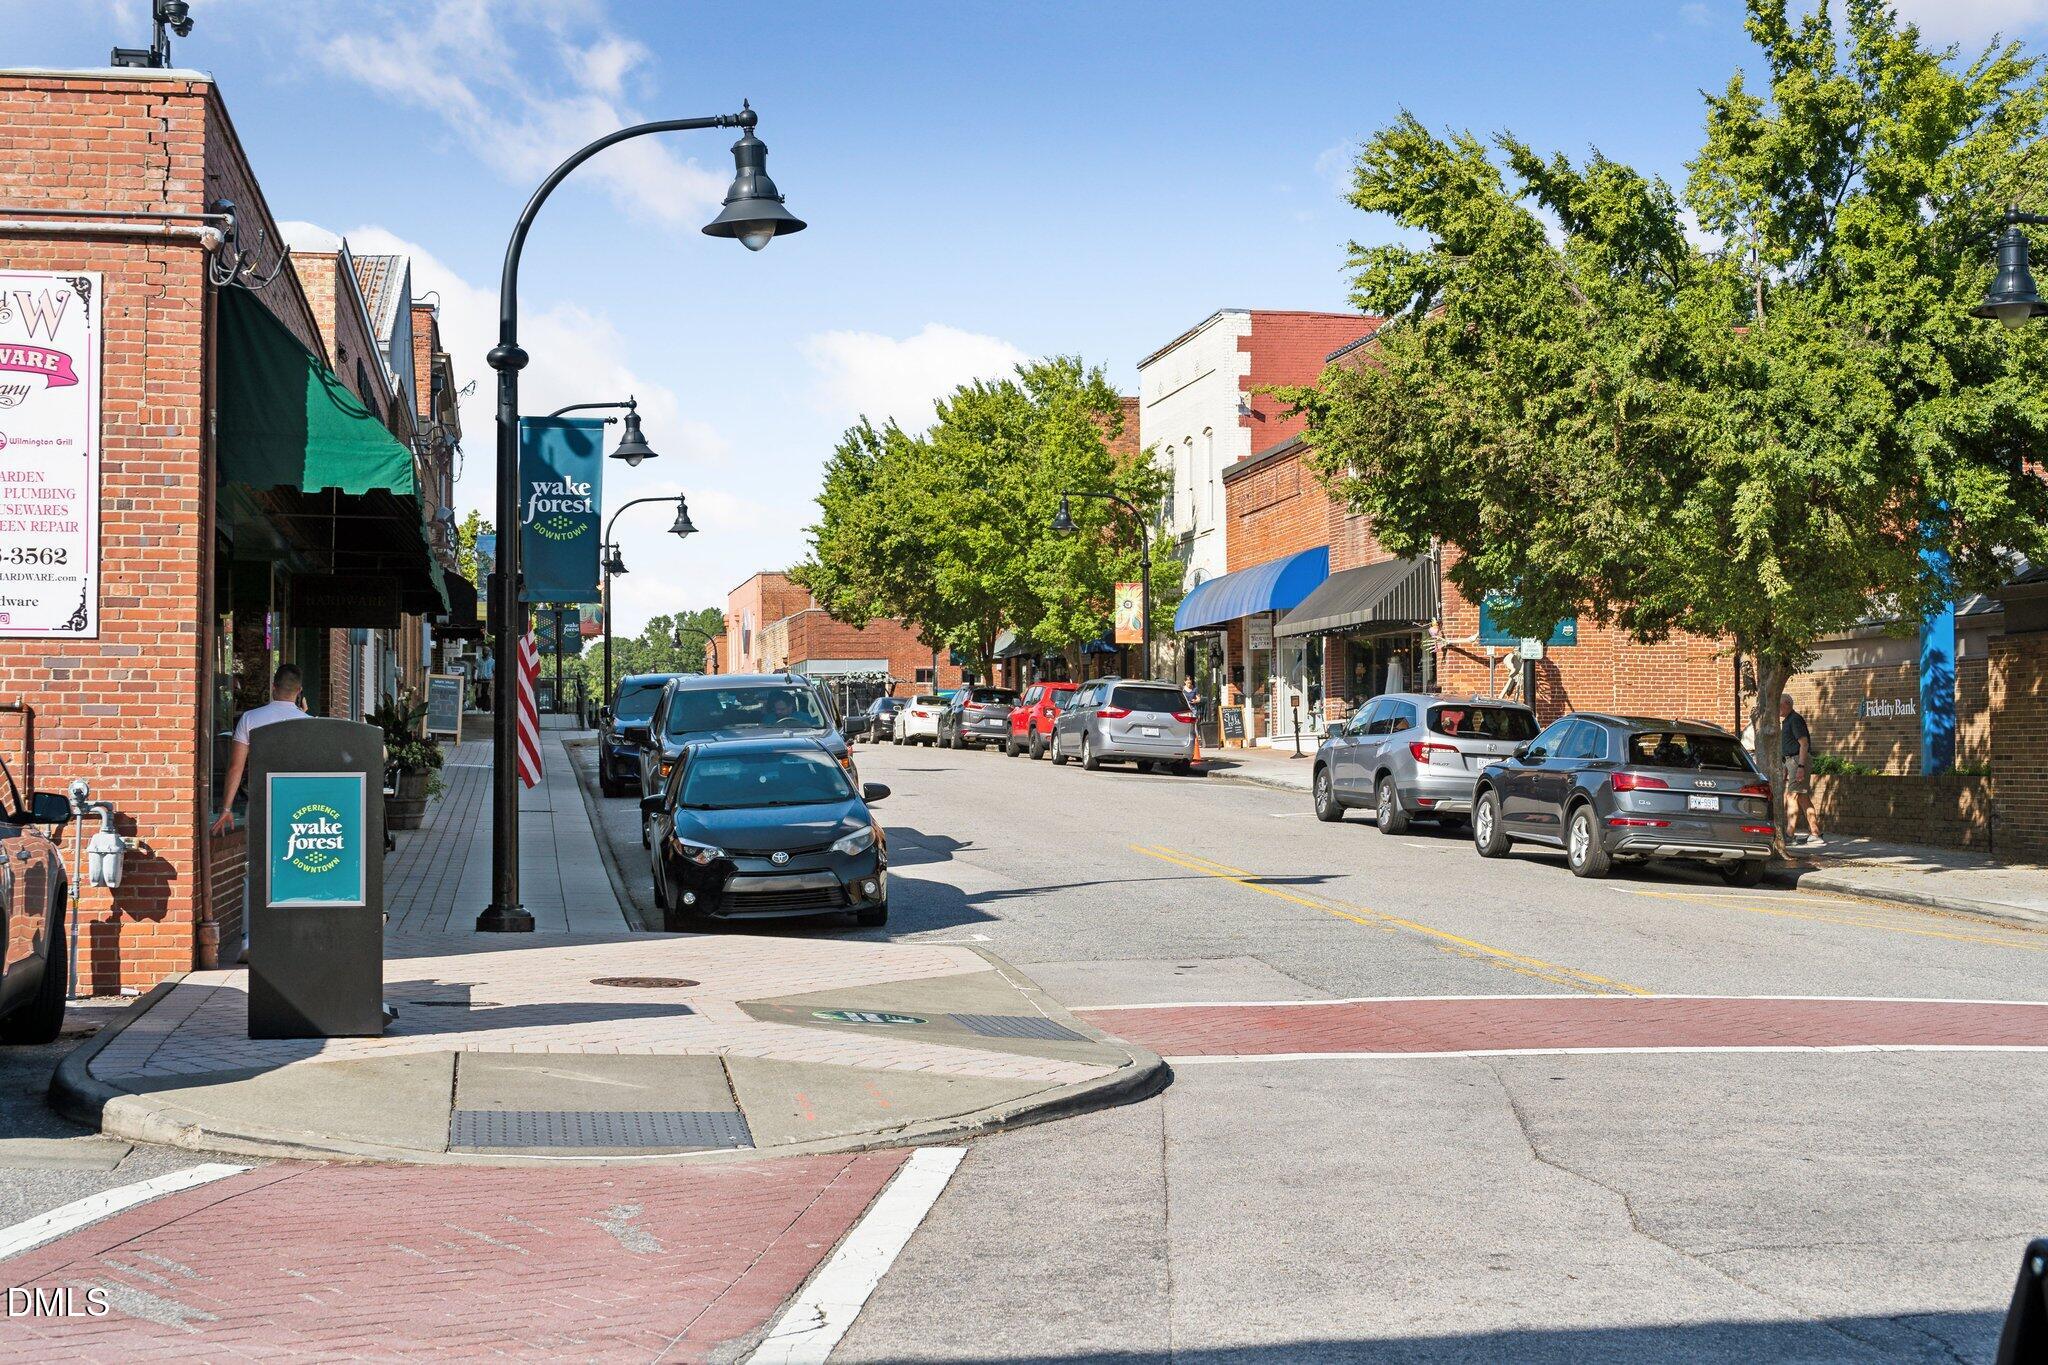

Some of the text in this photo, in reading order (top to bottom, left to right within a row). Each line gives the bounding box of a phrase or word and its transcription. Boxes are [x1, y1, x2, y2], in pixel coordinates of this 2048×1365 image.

[13, 288, 71, 341] W
[9, 437, 73, 447] Wilmington Grill
[4, 487, 76, 500] PLUMBING
[531, 475, 592, 496] wake
[522, 493, 593, 525] forest
[31, 520, 79, 533] REPAIR
[533, 522, 588, 541] DOWNTOWN
[0, 547, 68, 565] -3562
[0, 572, 77, 582] ARDWARE.com
[1866, 698, 1916, 720] Fidelity Bank
[292, 804, 340, 820] EXPERIENCE
[290, 817, 342, 835] wake
[282, 832, 344, 860] forest
[292, 857, 340, 873] DOWNTOWN
